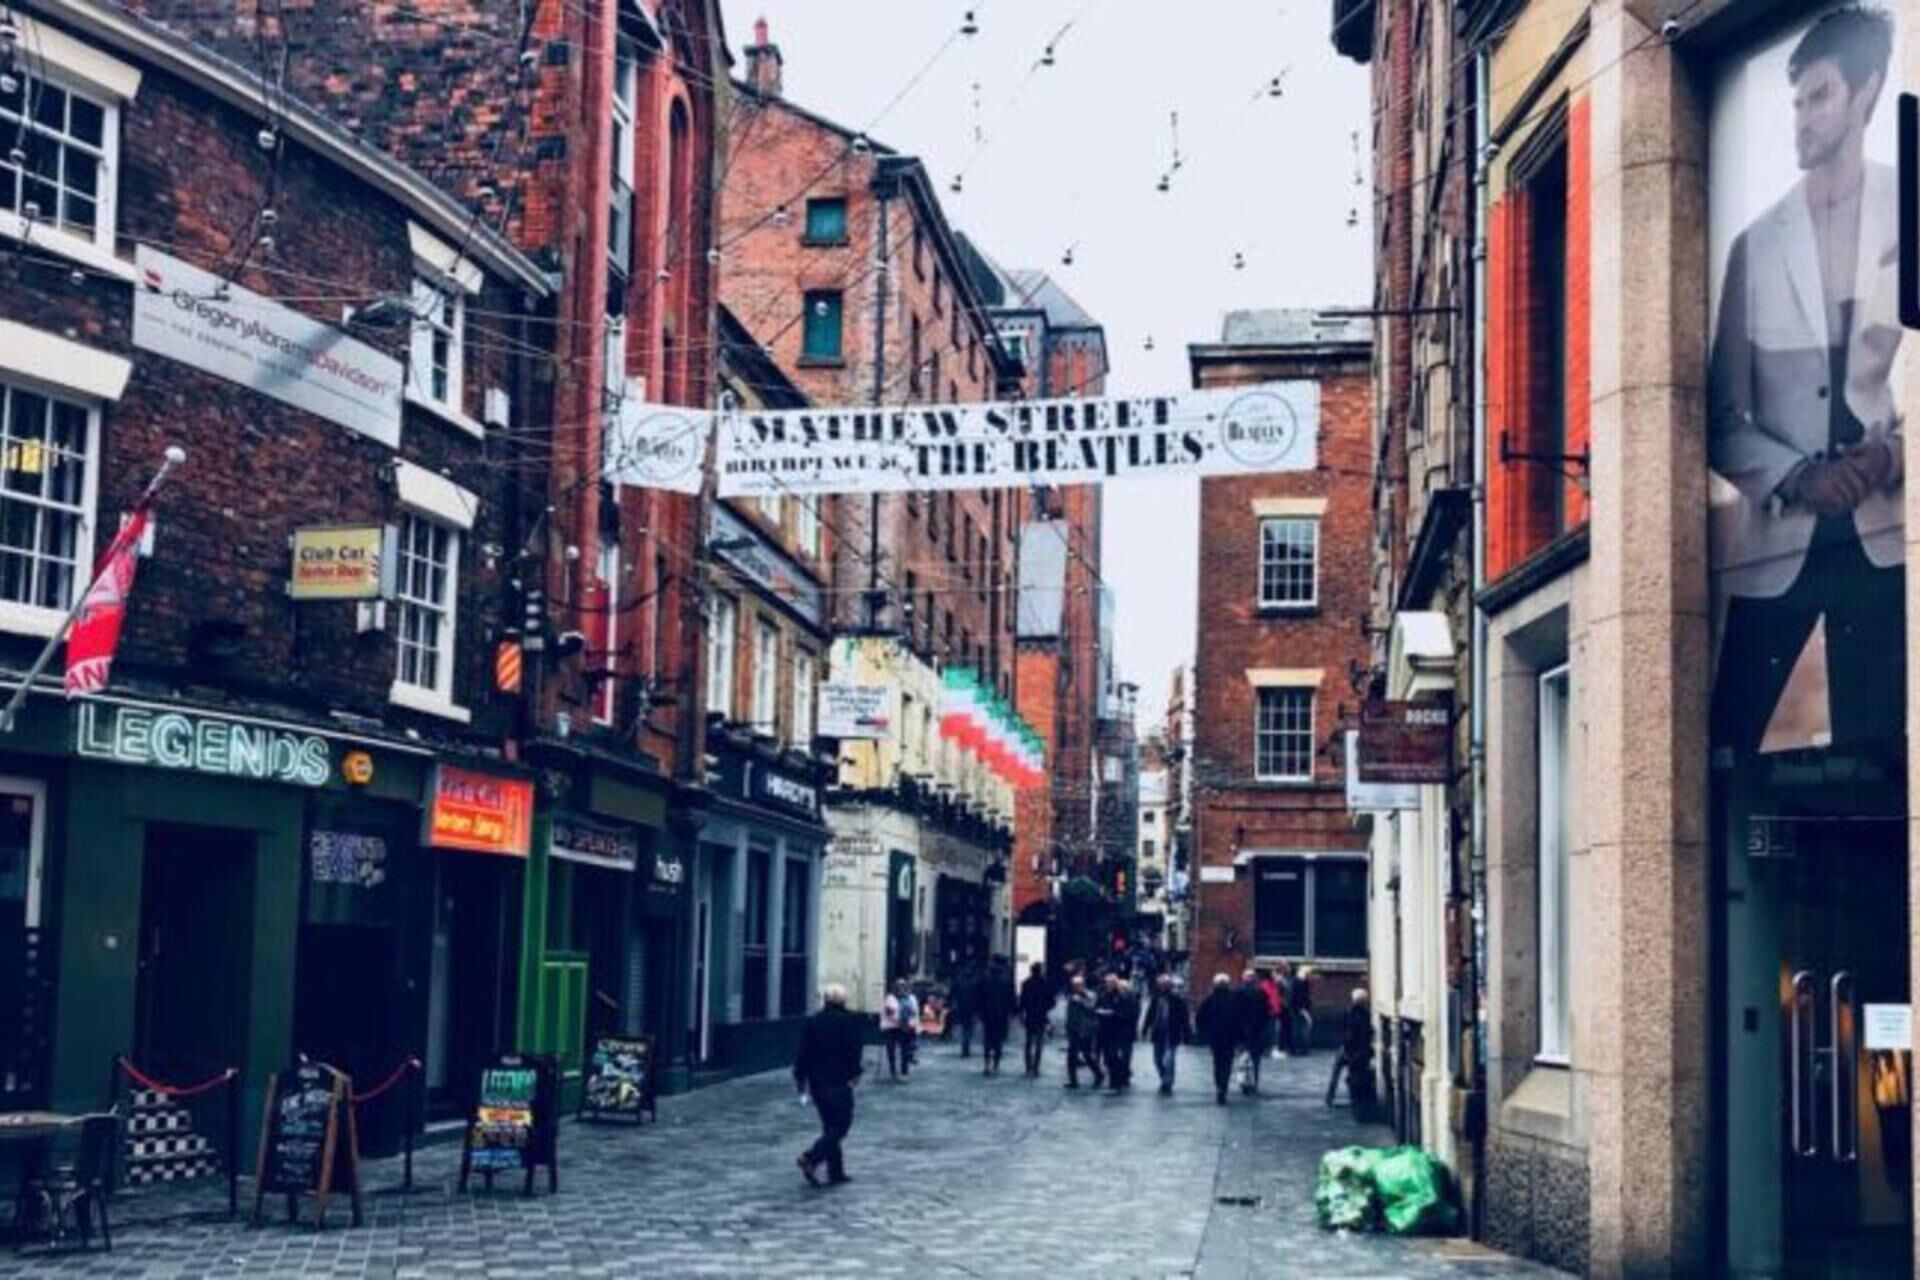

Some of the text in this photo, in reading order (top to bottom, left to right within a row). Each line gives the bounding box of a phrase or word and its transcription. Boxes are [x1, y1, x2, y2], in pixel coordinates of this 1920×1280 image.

[734, 397, 1178, 443] MATHEW STREET
[910, 441, 996, 476] THE
[1012, 429, 1204, 477] BEATLES
[77, 702, 330, 786] LEGENDS
